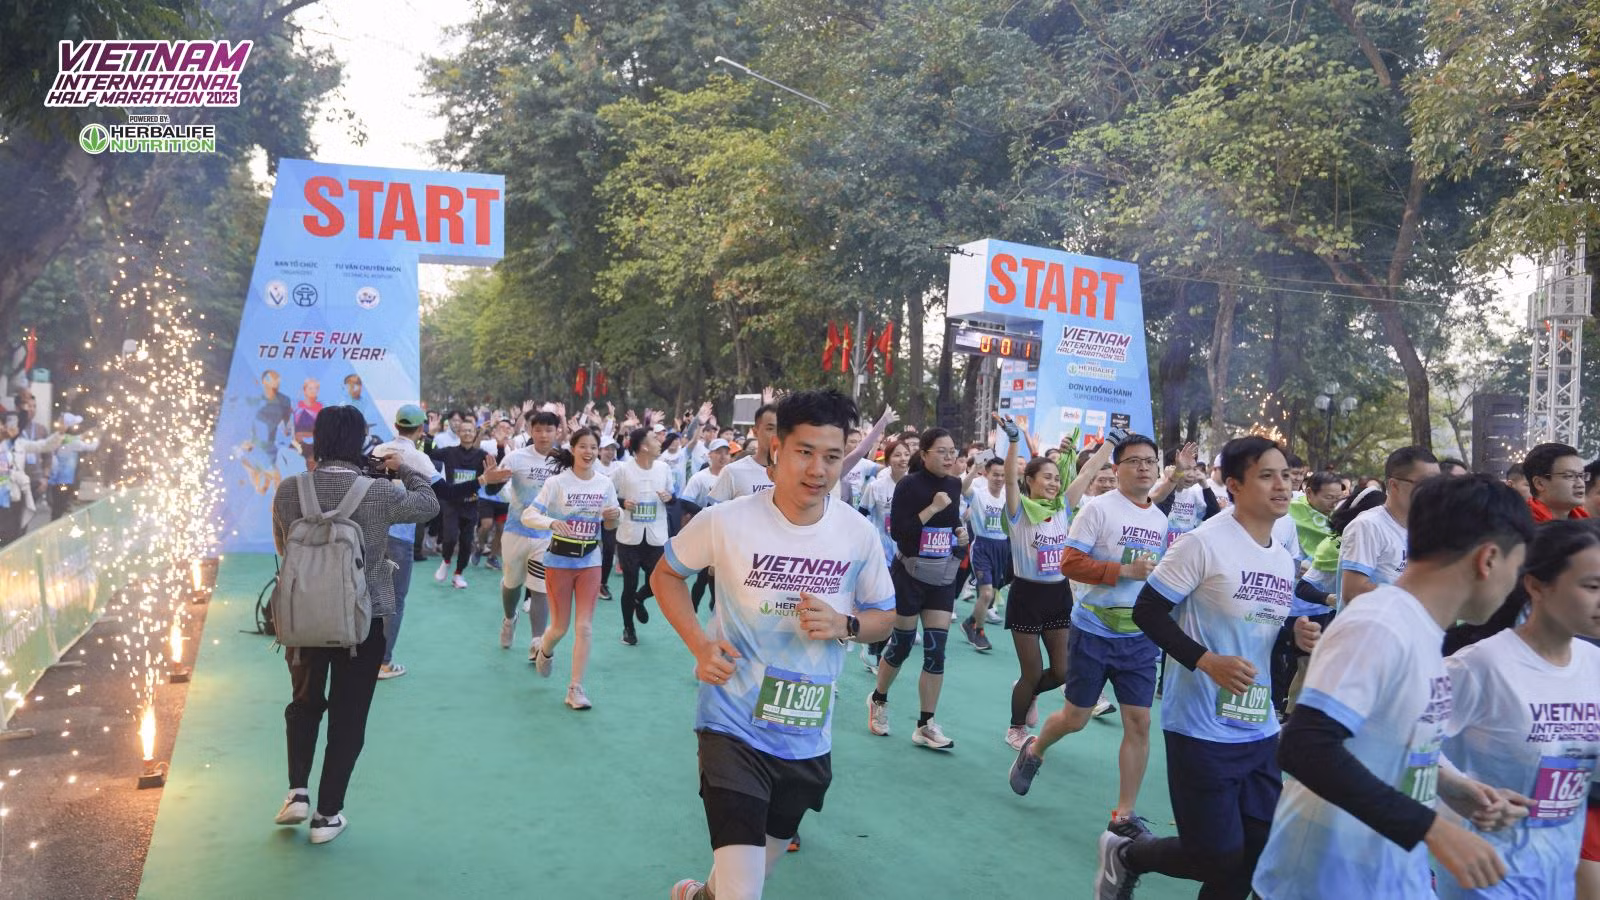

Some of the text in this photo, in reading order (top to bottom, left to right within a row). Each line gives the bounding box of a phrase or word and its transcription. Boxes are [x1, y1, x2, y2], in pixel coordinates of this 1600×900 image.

[302, 175, 500, 246] START
[987, 253, 1124, 321] START
[282, 331, 363, 345] LET'S RUN
[1063, 326, 1131, 347] VIETNAM
[259, 345, 386, 361] TO A NEW YEAR!
[1060, 339, 1126, 355] INTERNATIONAL
[927, 532, 950, 545] 16036
[1034, 531, 1067, 545] VIETNA
[752, 553, 851, 577] VIETNAM
[743, 578, 770, 589] HALF
[770, 583, 828, 594] MARATHON
[747, 570, 841, 587] INTERNATIONAL
[1232, 592, 1256, 600] HALF
[774, 680, 824, 711] 11302
[1550, 770, 1592, 800] 1625
